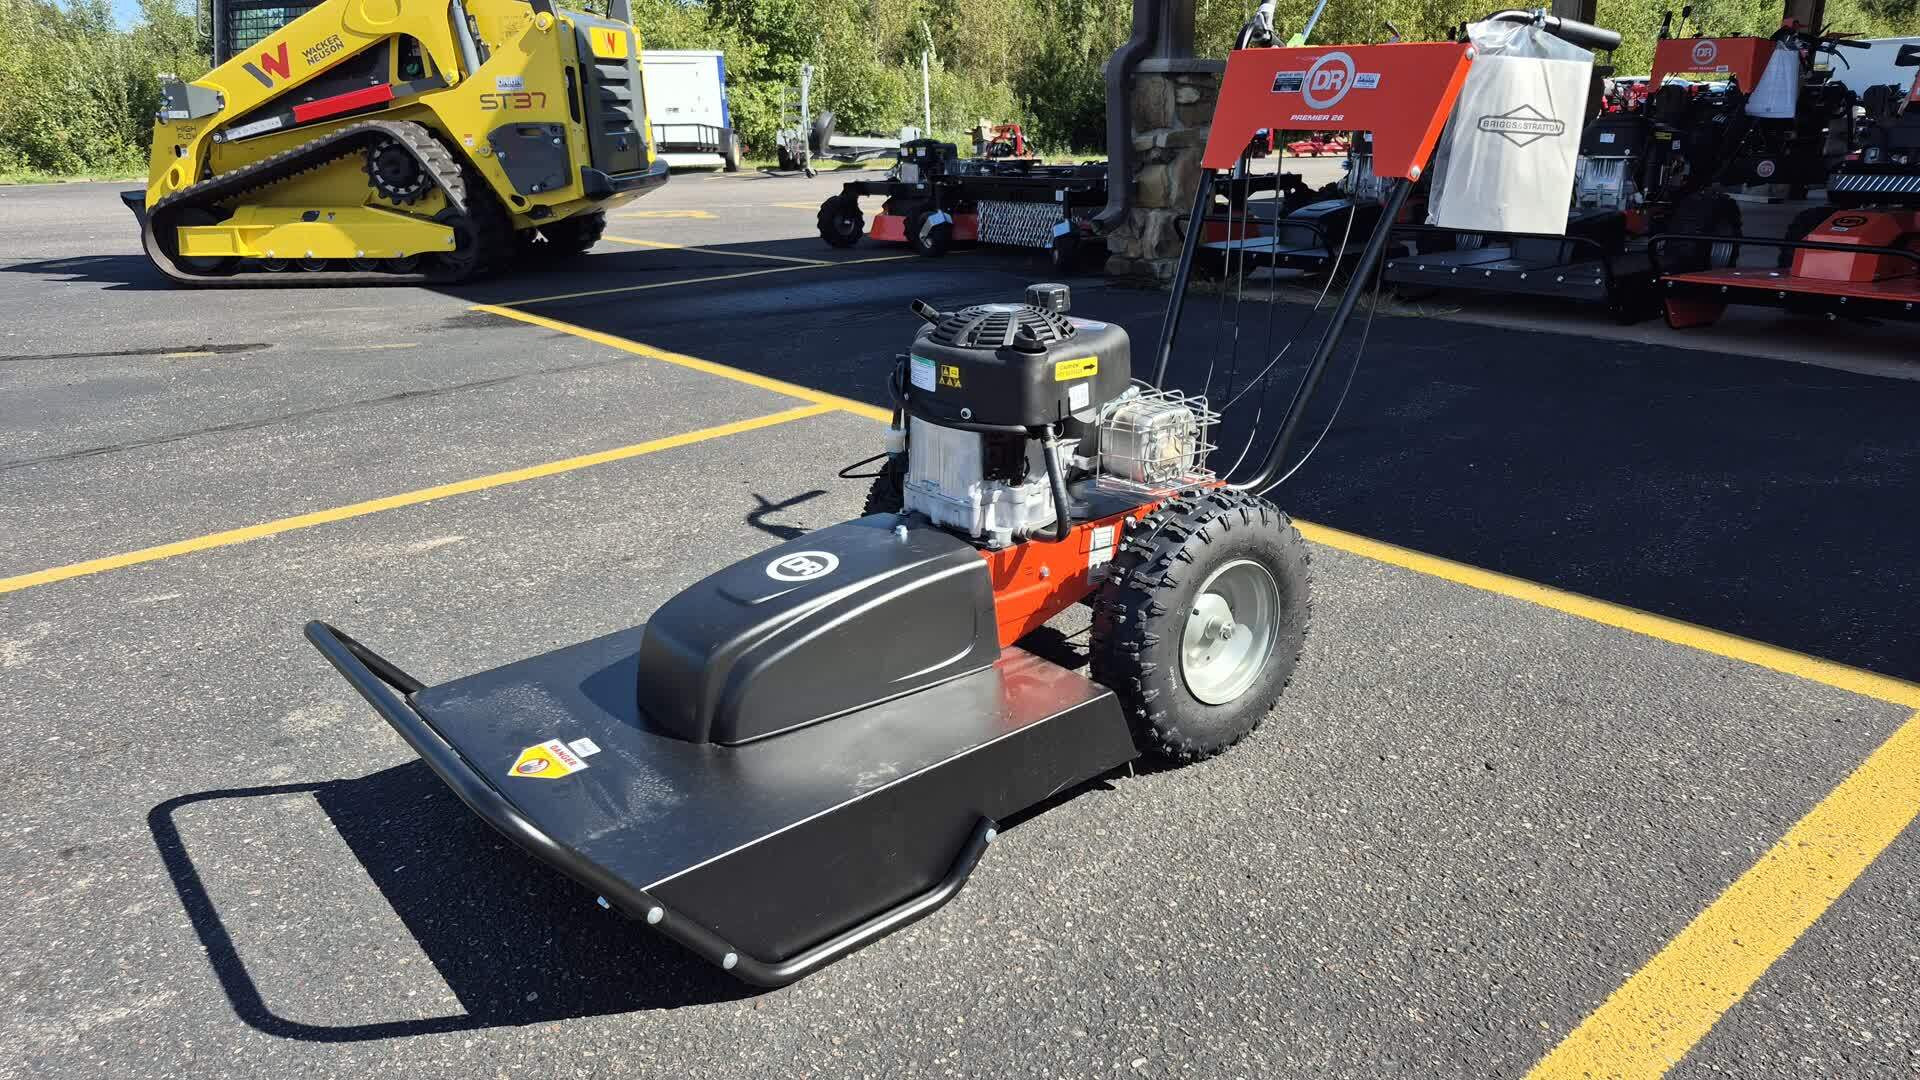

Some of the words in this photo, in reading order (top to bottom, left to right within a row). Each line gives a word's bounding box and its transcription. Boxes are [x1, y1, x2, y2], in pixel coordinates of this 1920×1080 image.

[302, 34, 341, 59] WACKER
[306, 41, 344, 66] NEUSON
[1696, 48, 1713, 57] DR
[1312, 69, 1345, 90] DR
[480, 92, 546, 110] ST37
[1483, 120, 1517, 129] BRIGGS
[1523, 122, 1561, 132] STRATTON
[780, 556, 824, 576] DR
[550, 744, 577, 767] DANGER
